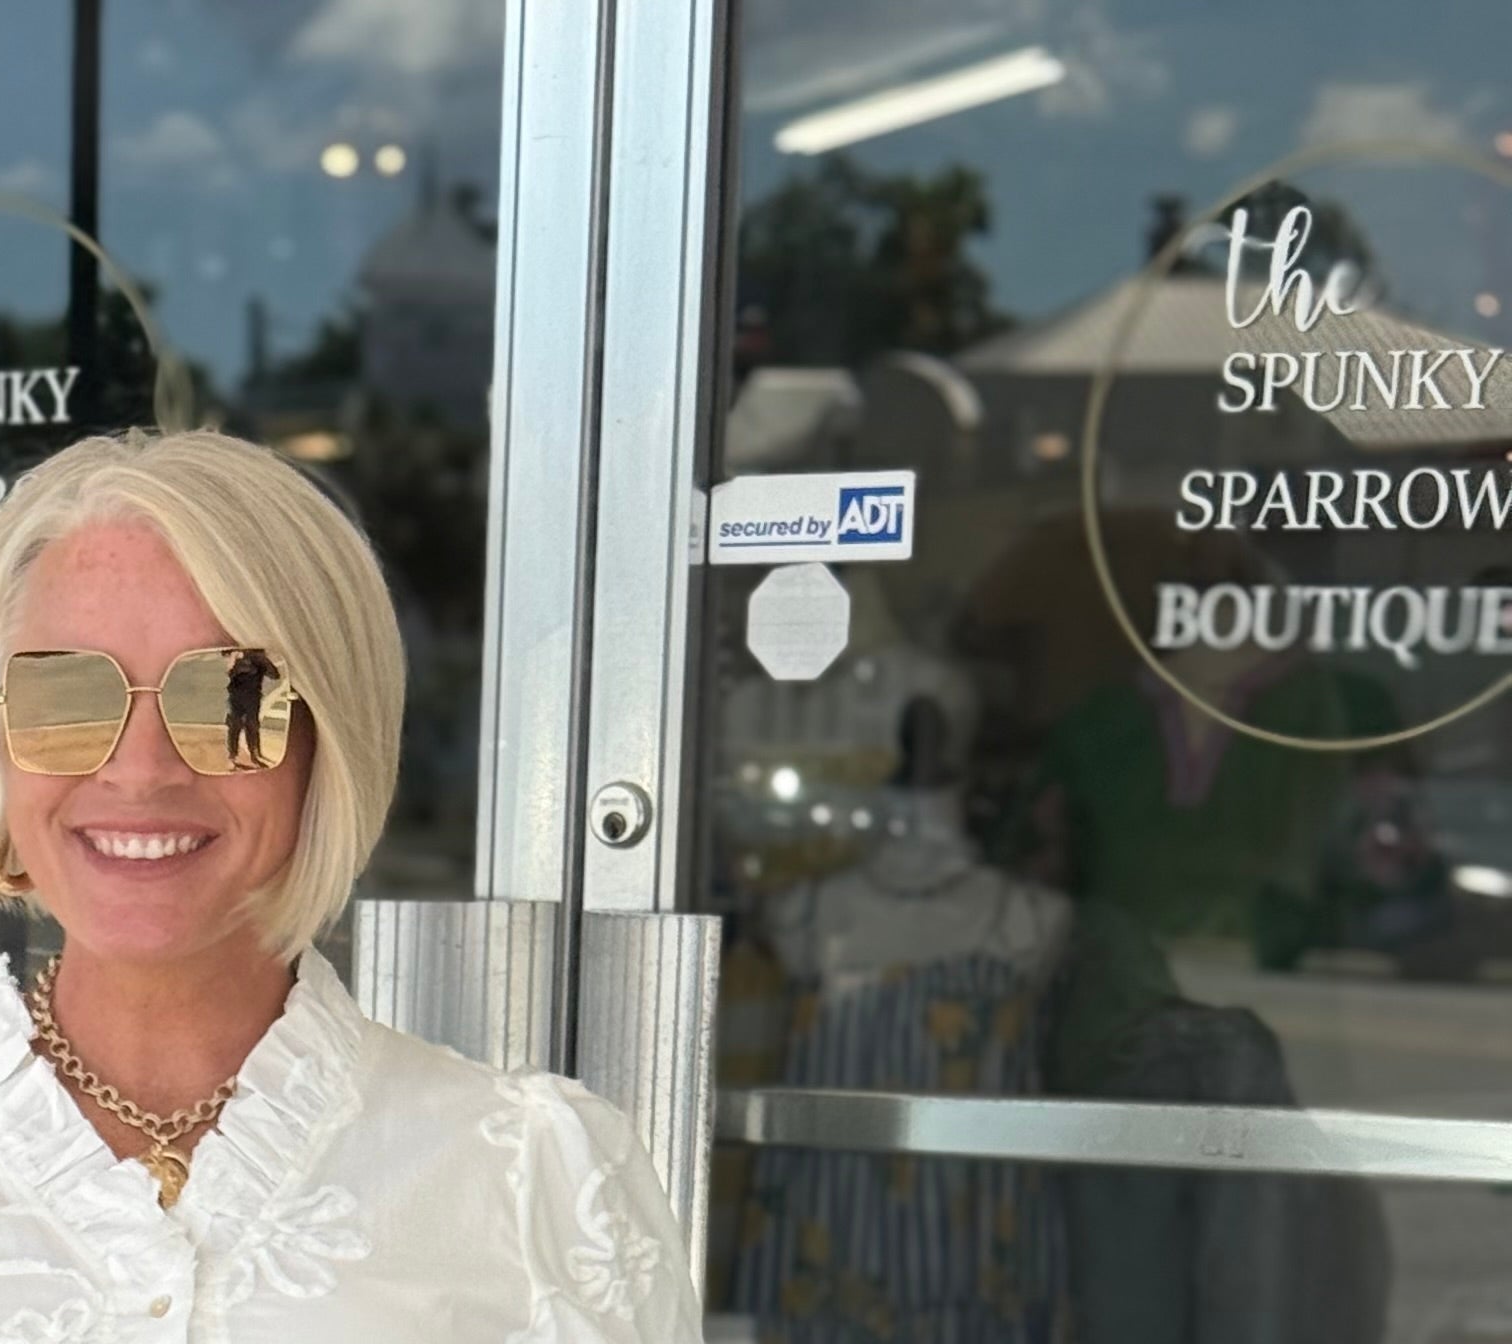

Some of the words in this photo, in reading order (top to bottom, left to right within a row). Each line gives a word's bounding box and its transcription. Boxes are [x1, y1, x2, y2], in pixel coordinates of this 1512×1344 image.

[1184, 206, 1380, 332] the
[1218, 348, 1504, 413] SPUNKY
[719, 517, 804, 538] secured
[807, 517, 832, 538] by
[839, 496, 904, 534] ADT
[1176, 467, 1512, 531] SPARROW
[1155, 583, 1512, 669] BOUTIQUE
